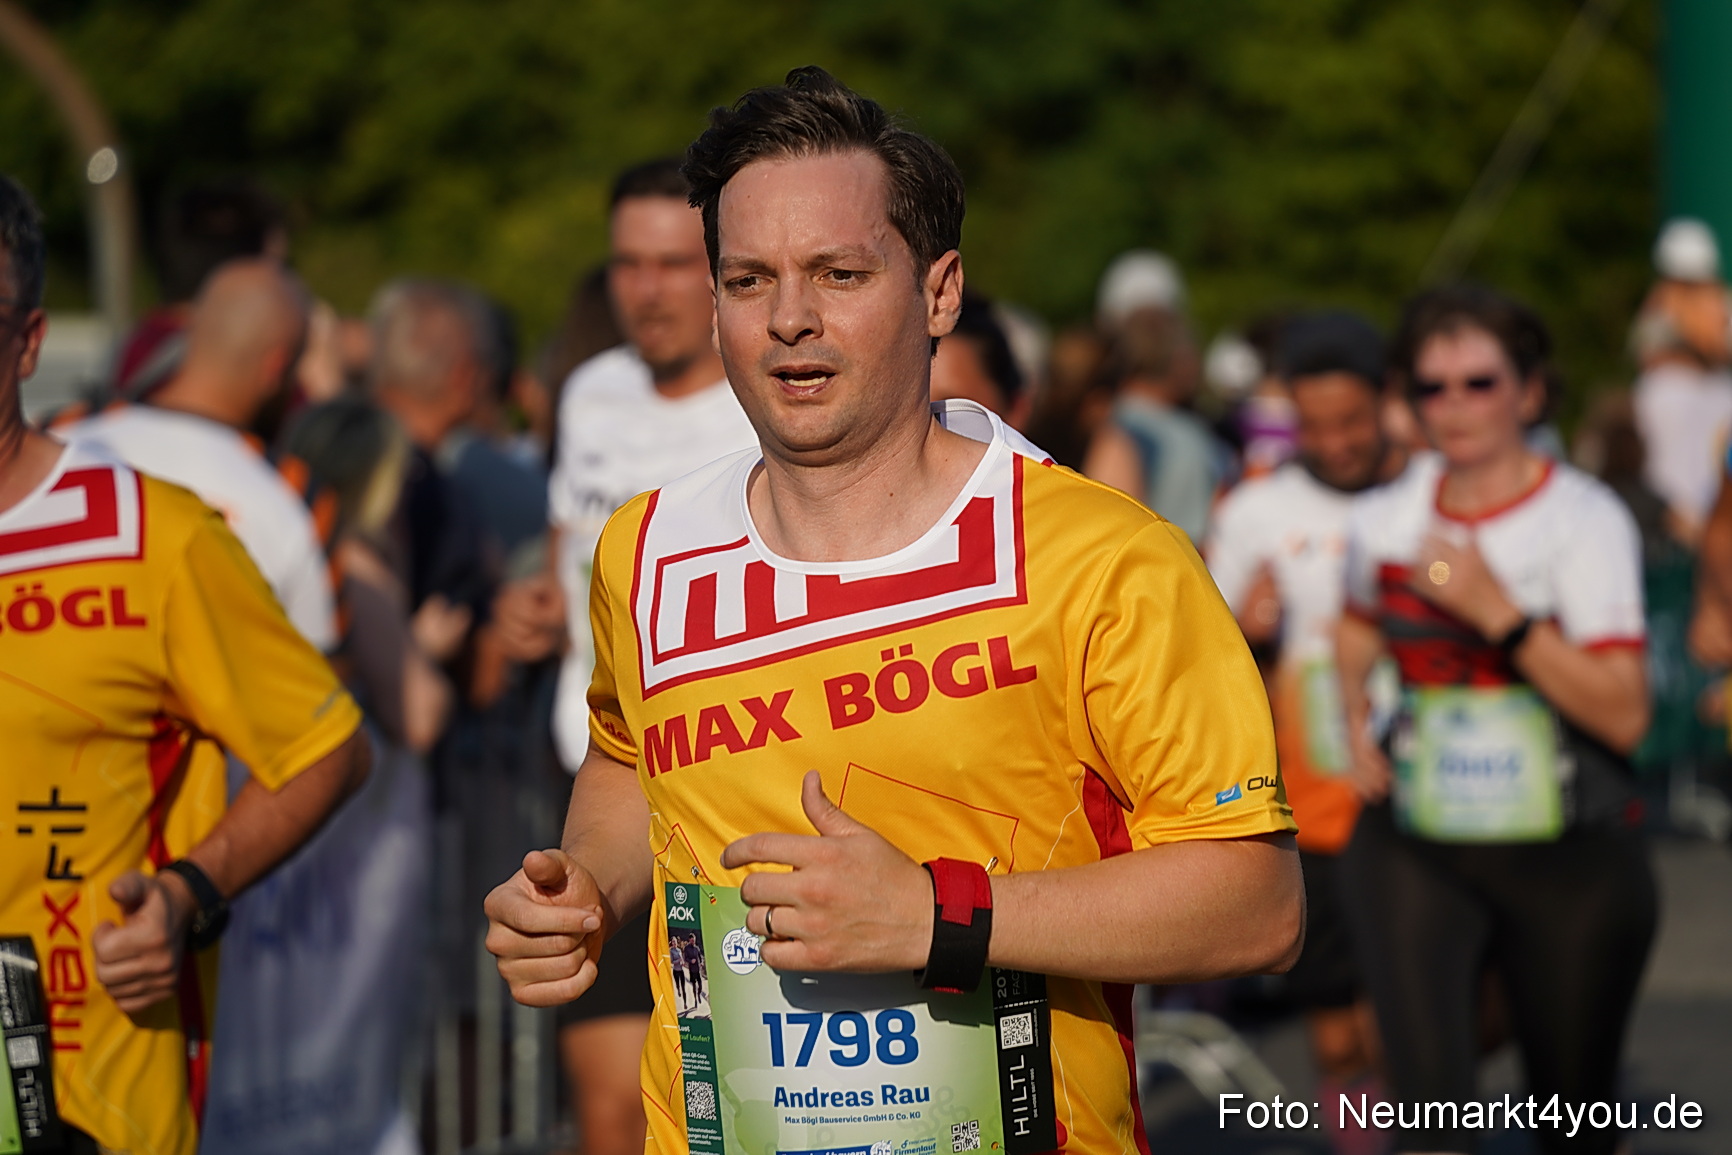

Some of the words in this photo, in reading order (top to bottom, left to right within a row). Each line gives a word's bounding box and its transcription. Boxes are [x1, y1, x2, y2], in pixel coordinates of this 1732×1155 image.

[0, 582, 147, 634] ÖGL
[643, 688, 803, 779] MAX
[823, 635, 1038, 732] BÖGL
[668, 905, 695, 922] AOK
[762, 1008, 919, 1069] 1798
[773, 1086, 874, 1108] Andreas
[880, 1084, 931, 1106] Rau
[784, 1116, 800, 1124] Max
[801, 1116, 818, 1126] Bögl
[819, 1115, 862, 1124] Bauservice
[863, 1113, 887, 1122] GmbH
[888, 1113, 894, 1121] &
[896, 1112, 908, 1120] Co.
[1009, 1054, 1031, 1137] HILTL
